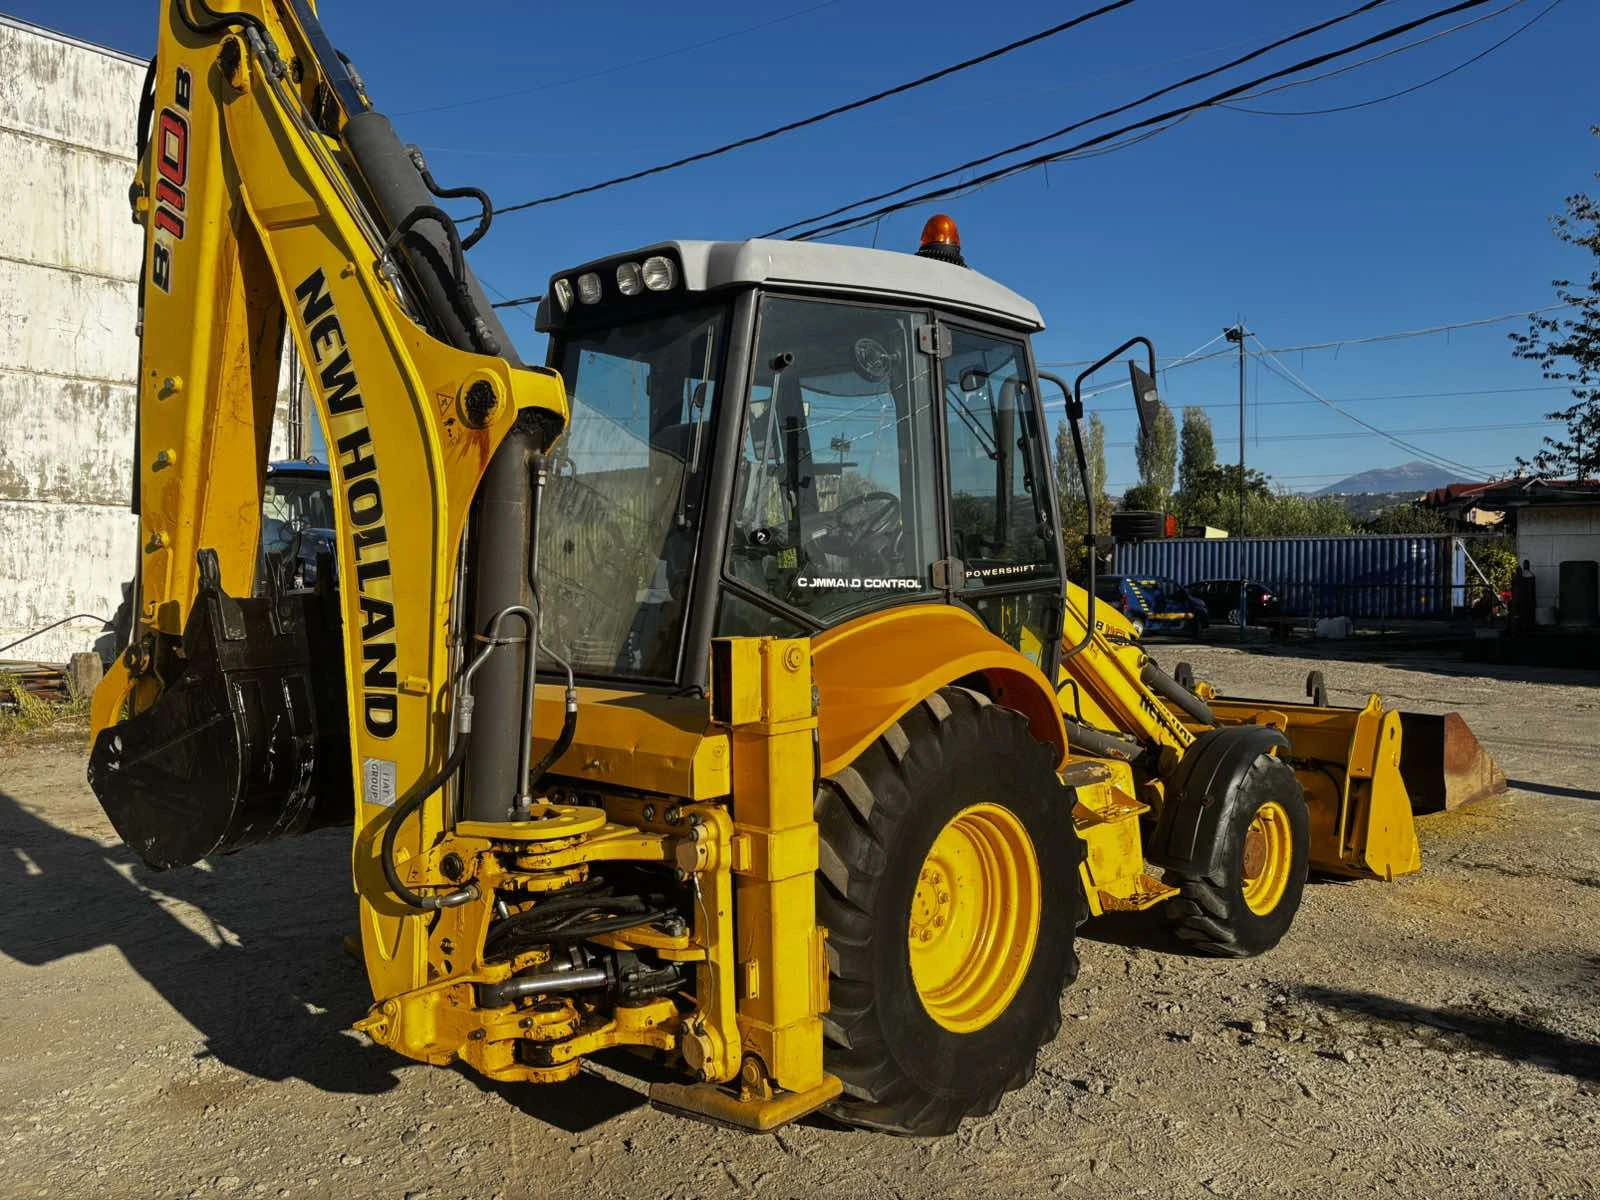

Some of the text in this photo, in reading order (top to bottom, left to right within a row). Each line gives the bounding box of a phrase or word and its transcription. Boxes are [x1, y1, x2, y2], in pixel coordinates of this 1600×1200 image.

[152, 66, 191, 294] B 110 B
[294, 267, 398, 738] NEW HOLLAND
[864, 579, 922, 588] CONTROL
[966, 564, 1036, 578] POWERSHIFT
[371, 763, 379, 799] GROUP
